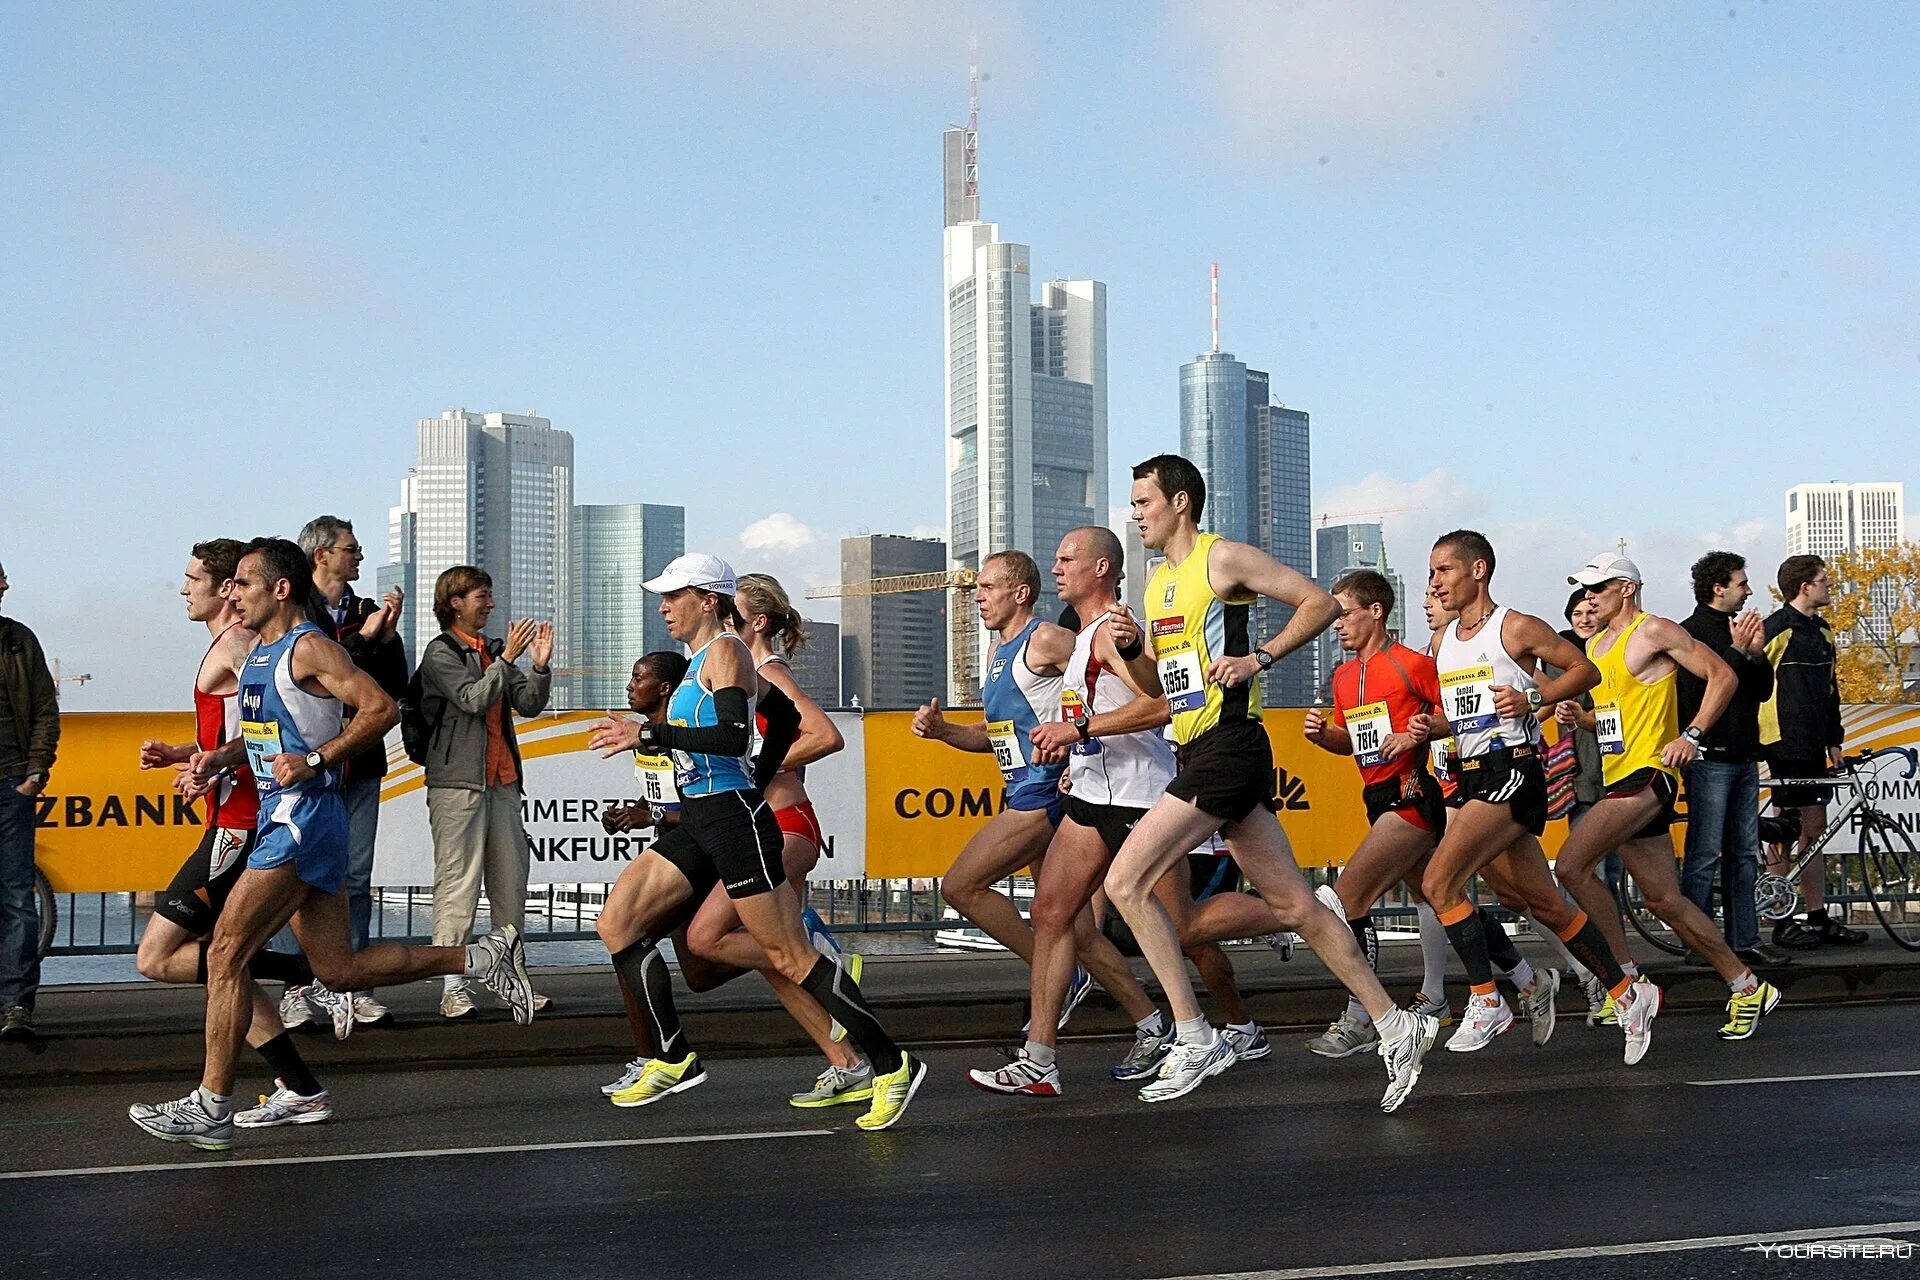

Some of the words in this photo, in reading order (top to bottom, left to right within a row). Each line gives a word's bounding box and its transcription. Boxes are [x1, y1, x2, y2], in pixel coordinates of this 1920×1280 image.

[1163, 668, 1189, 695] 3955
[1454, 694, 1481, 716] 7957
[1356, 729, 1379, 751] 7814
[646, 781, 661, 799] F15
[895, 787, 1007, 819] COM
[726, 878, 754, 889] cocoon
